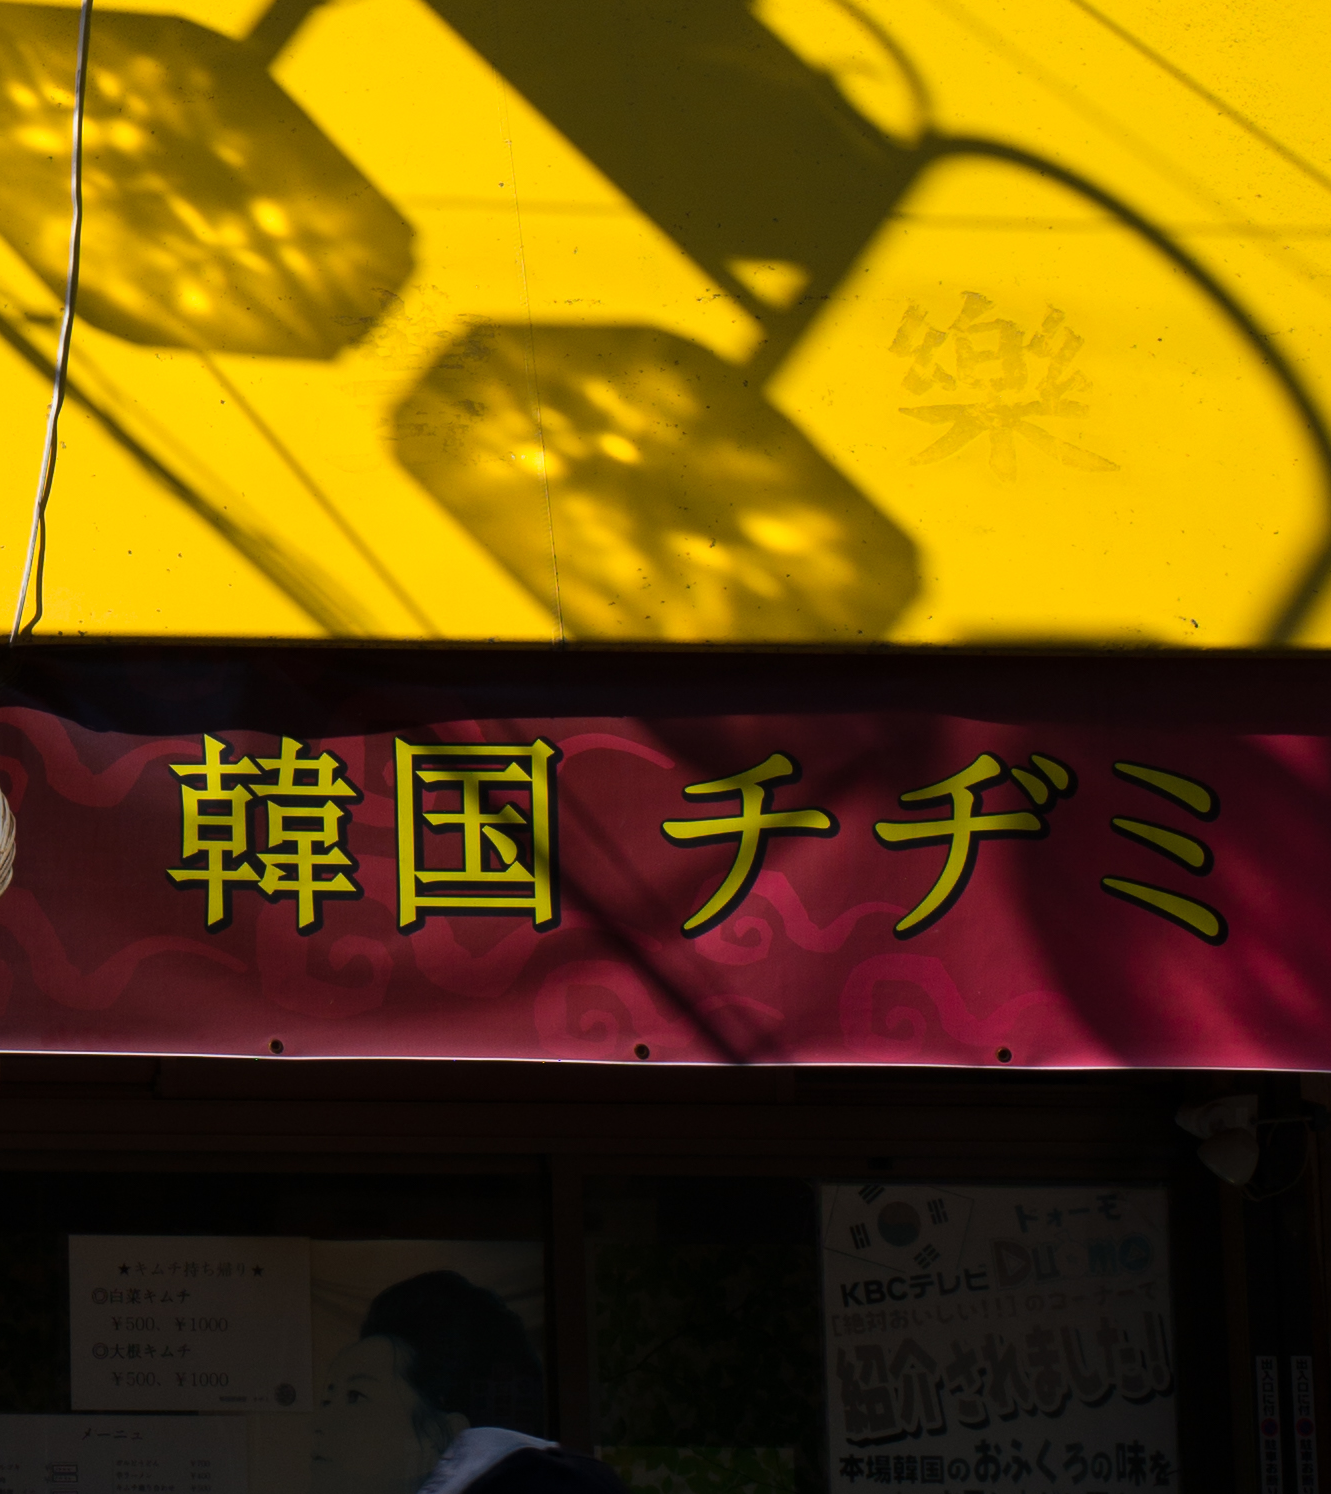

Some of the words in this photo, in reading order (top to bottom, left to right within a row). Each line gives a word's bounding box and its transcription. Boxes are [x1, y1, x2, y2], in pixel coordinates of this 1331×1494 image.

[165, 733, 562, 935] 韓国
[661, 749, 1229, 944] チヂミ
[841, 1266, 990, 1307] KBCテレビ
[839, 1439, 1172, 1487] 本場韓国のおふくろの味を
